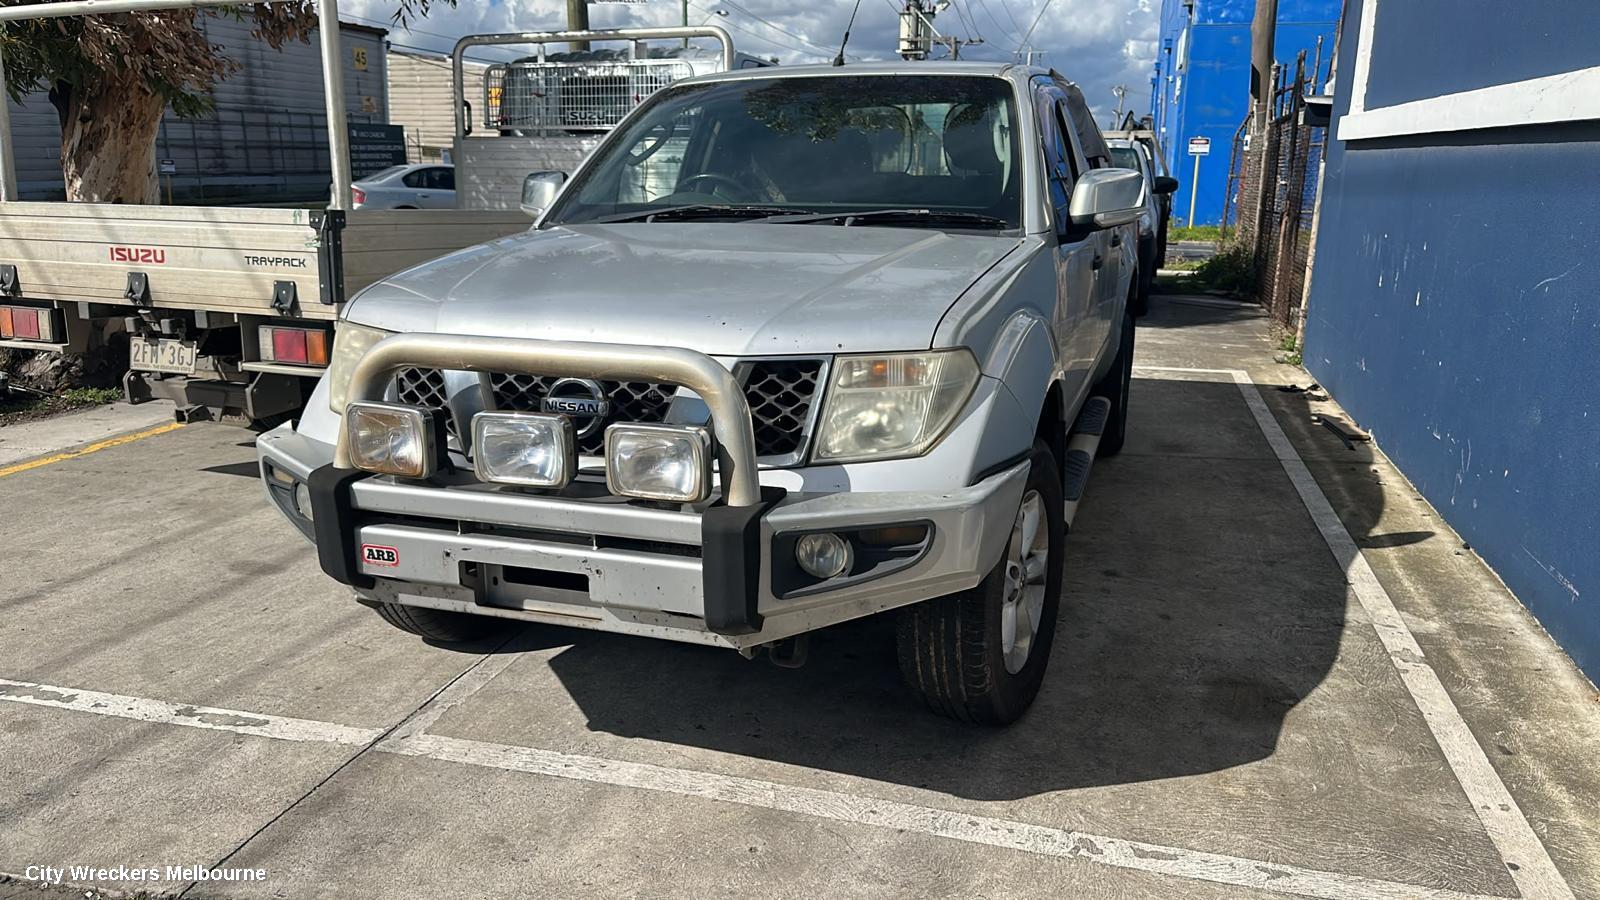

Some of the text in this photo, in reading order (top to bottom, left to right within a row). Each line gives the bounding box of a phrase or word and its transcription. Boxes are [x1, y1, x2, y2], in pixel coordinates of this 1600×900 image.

[110, 247, 166, 264] ISUZU
[244, 255, 306, 268] TRAYPACK
[133, 342, 194, 367] 2FM 3GJ
[544, 400, 599, 413] NISSAN
[366, 548, 396, 562] ARB
